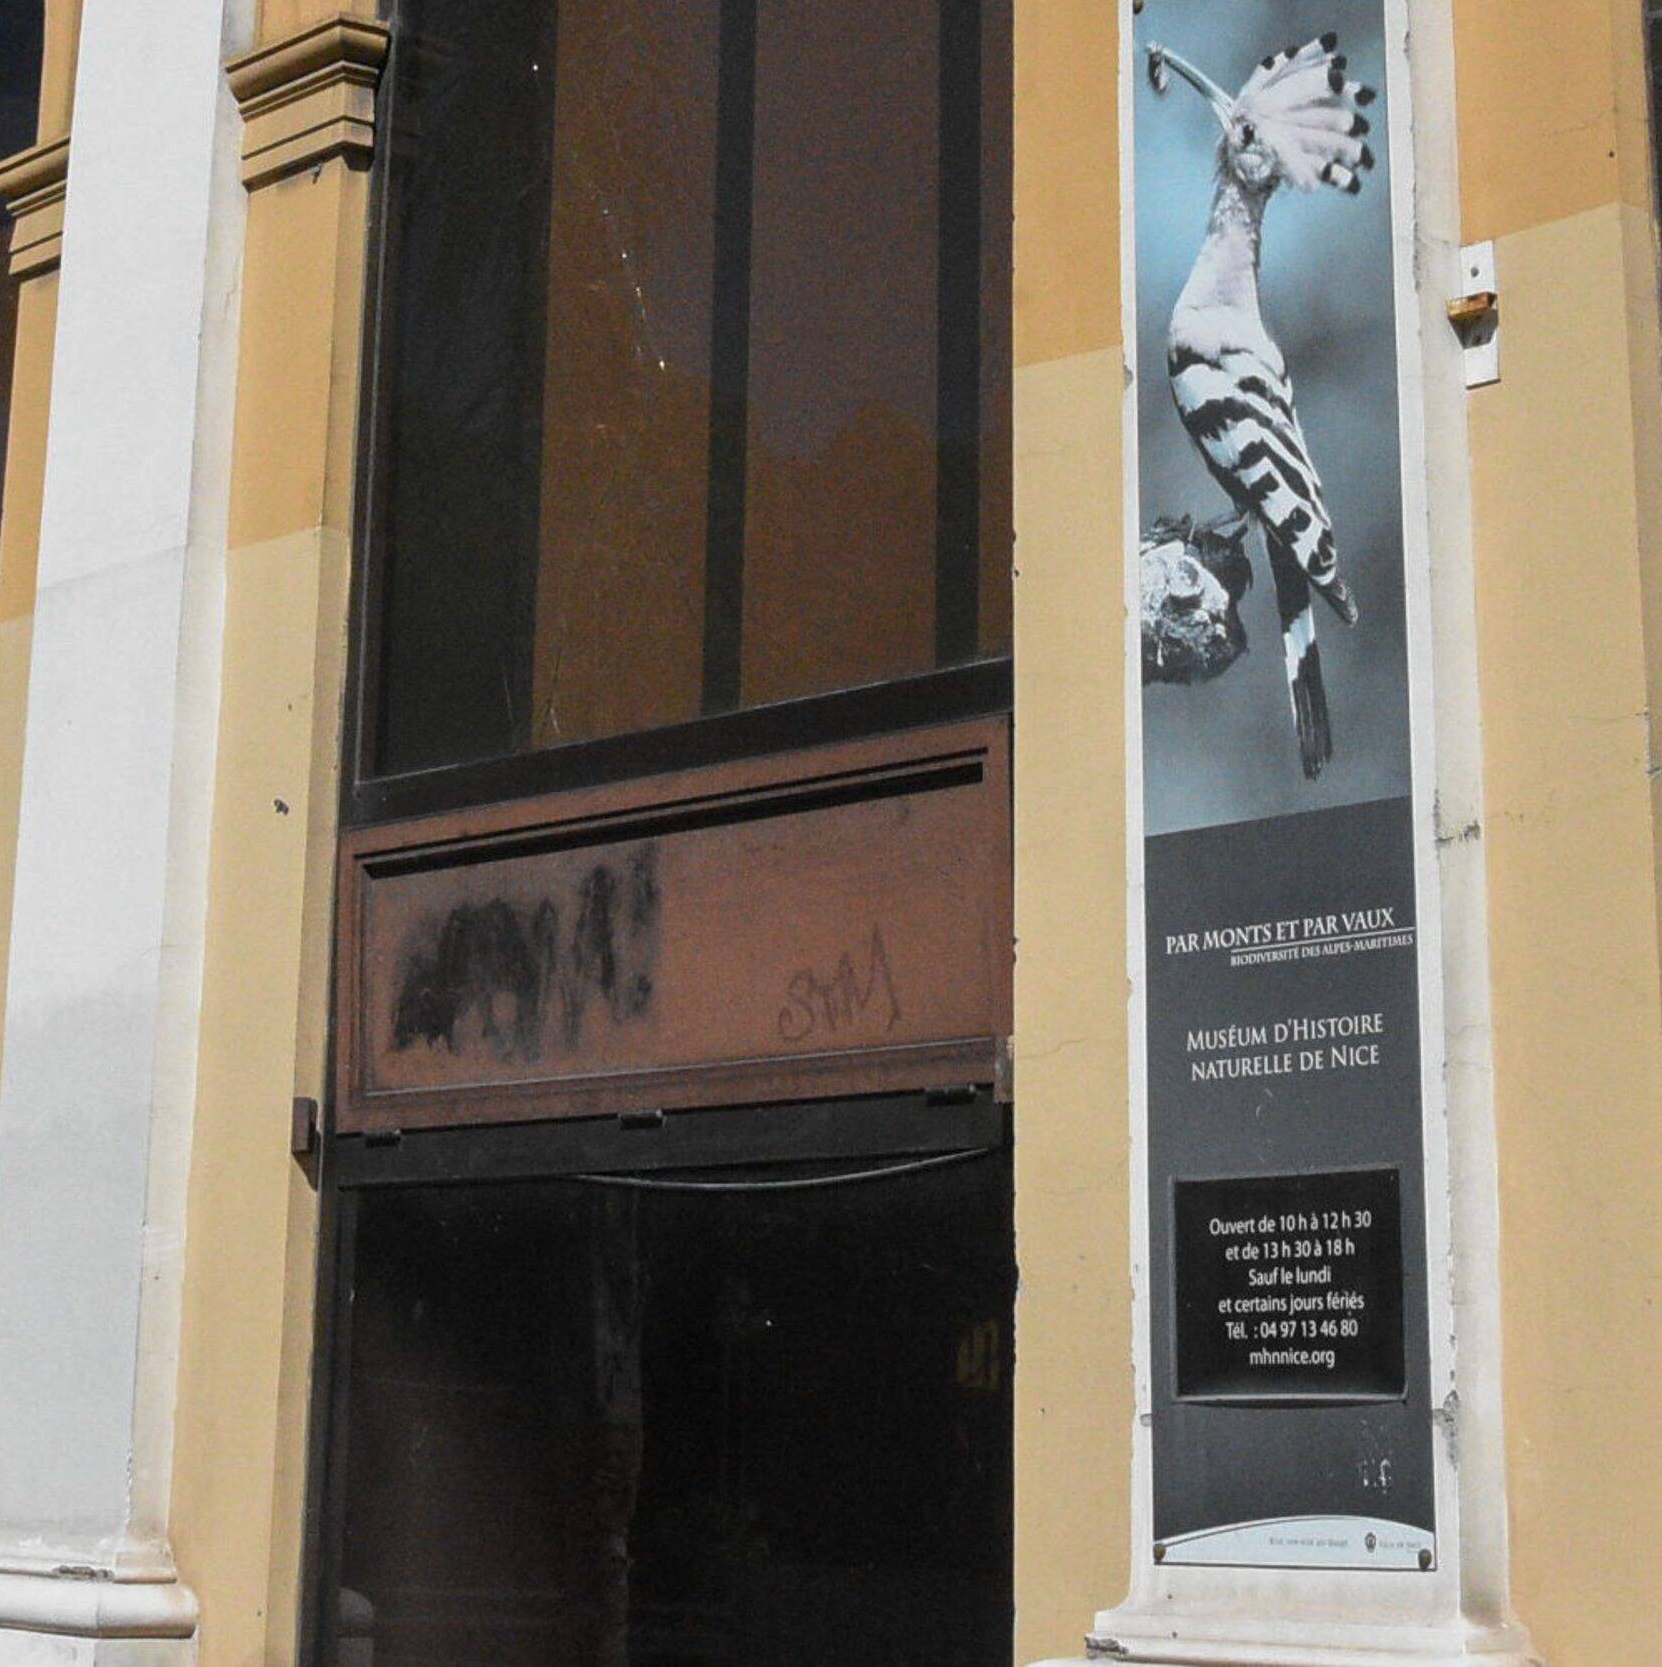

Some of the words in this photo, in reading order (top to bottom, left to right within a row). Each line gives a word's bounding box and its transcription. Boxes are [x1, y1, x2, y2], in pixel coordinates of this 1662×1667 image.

[1165, 934, 1200, 955] PAR
[1202, 922, 1272, 950] MONTS
[1277, 920, 1299, 941] ET
[1304, 914, 1339, 937] PAR
[1341, 907, 1395, 931] VAUX
[1301, 945, 1321, 958] DES
[1322, 934, 1414, 956] ALPES-MARITIMES
[1191, 1052, 1293, 1081] NATURELLE
[1300, 1051, 1324, 1071] DE
[1209, 1218, 1256, 1236] Ouvert
[1258, 1215, 1276, 1233] de
[1280, 1215, 1295, 1232] 10
[1299, 1213, 1307, 1230] h
[1310, 1214, 1318, 1230] à
[1323, 1212, 1338, 1229] 12
[1342, 1210, 1351, 1228] h
[1354, 1211, 1372, 1228] 30
[1225, 1245, 1239, 1261] et
[1242, 1243, 1259, 1260] de
[1263, 1242, 1278, 1259] 13
[1282, 1241, 1291, 1258] h
[1294, 1240, 1310, 1258] 30
[1314, 1239, 1322, 1257] à
[1327, 1239, 1342, 1256] 18
[1345, 1237, 1355, 1255] h
[1248, 1267, 1278, 1286] Sauf
[1280, 1266, 1294, 1284] le
[1296, 1265, 1332, 1284] lundi
[1218, 1298, 1232, 1313] et
[1234, 1294, 1287, 1313] certains
[1289, 1293, 1324, 1316] jours
[1326, 1290, 1364, 1310] fériés
[1260, 1321, 1277, 1339] 04
[1280, 1321, 1296, 1338] 97
[1301, 1320, 1317, 1337] 13
[1320, 1320, 1337, 1337] 46
[1341, 1319, 1358, 1337] 80
[1249, 1346, 1335, 1368] mhnnice.org
